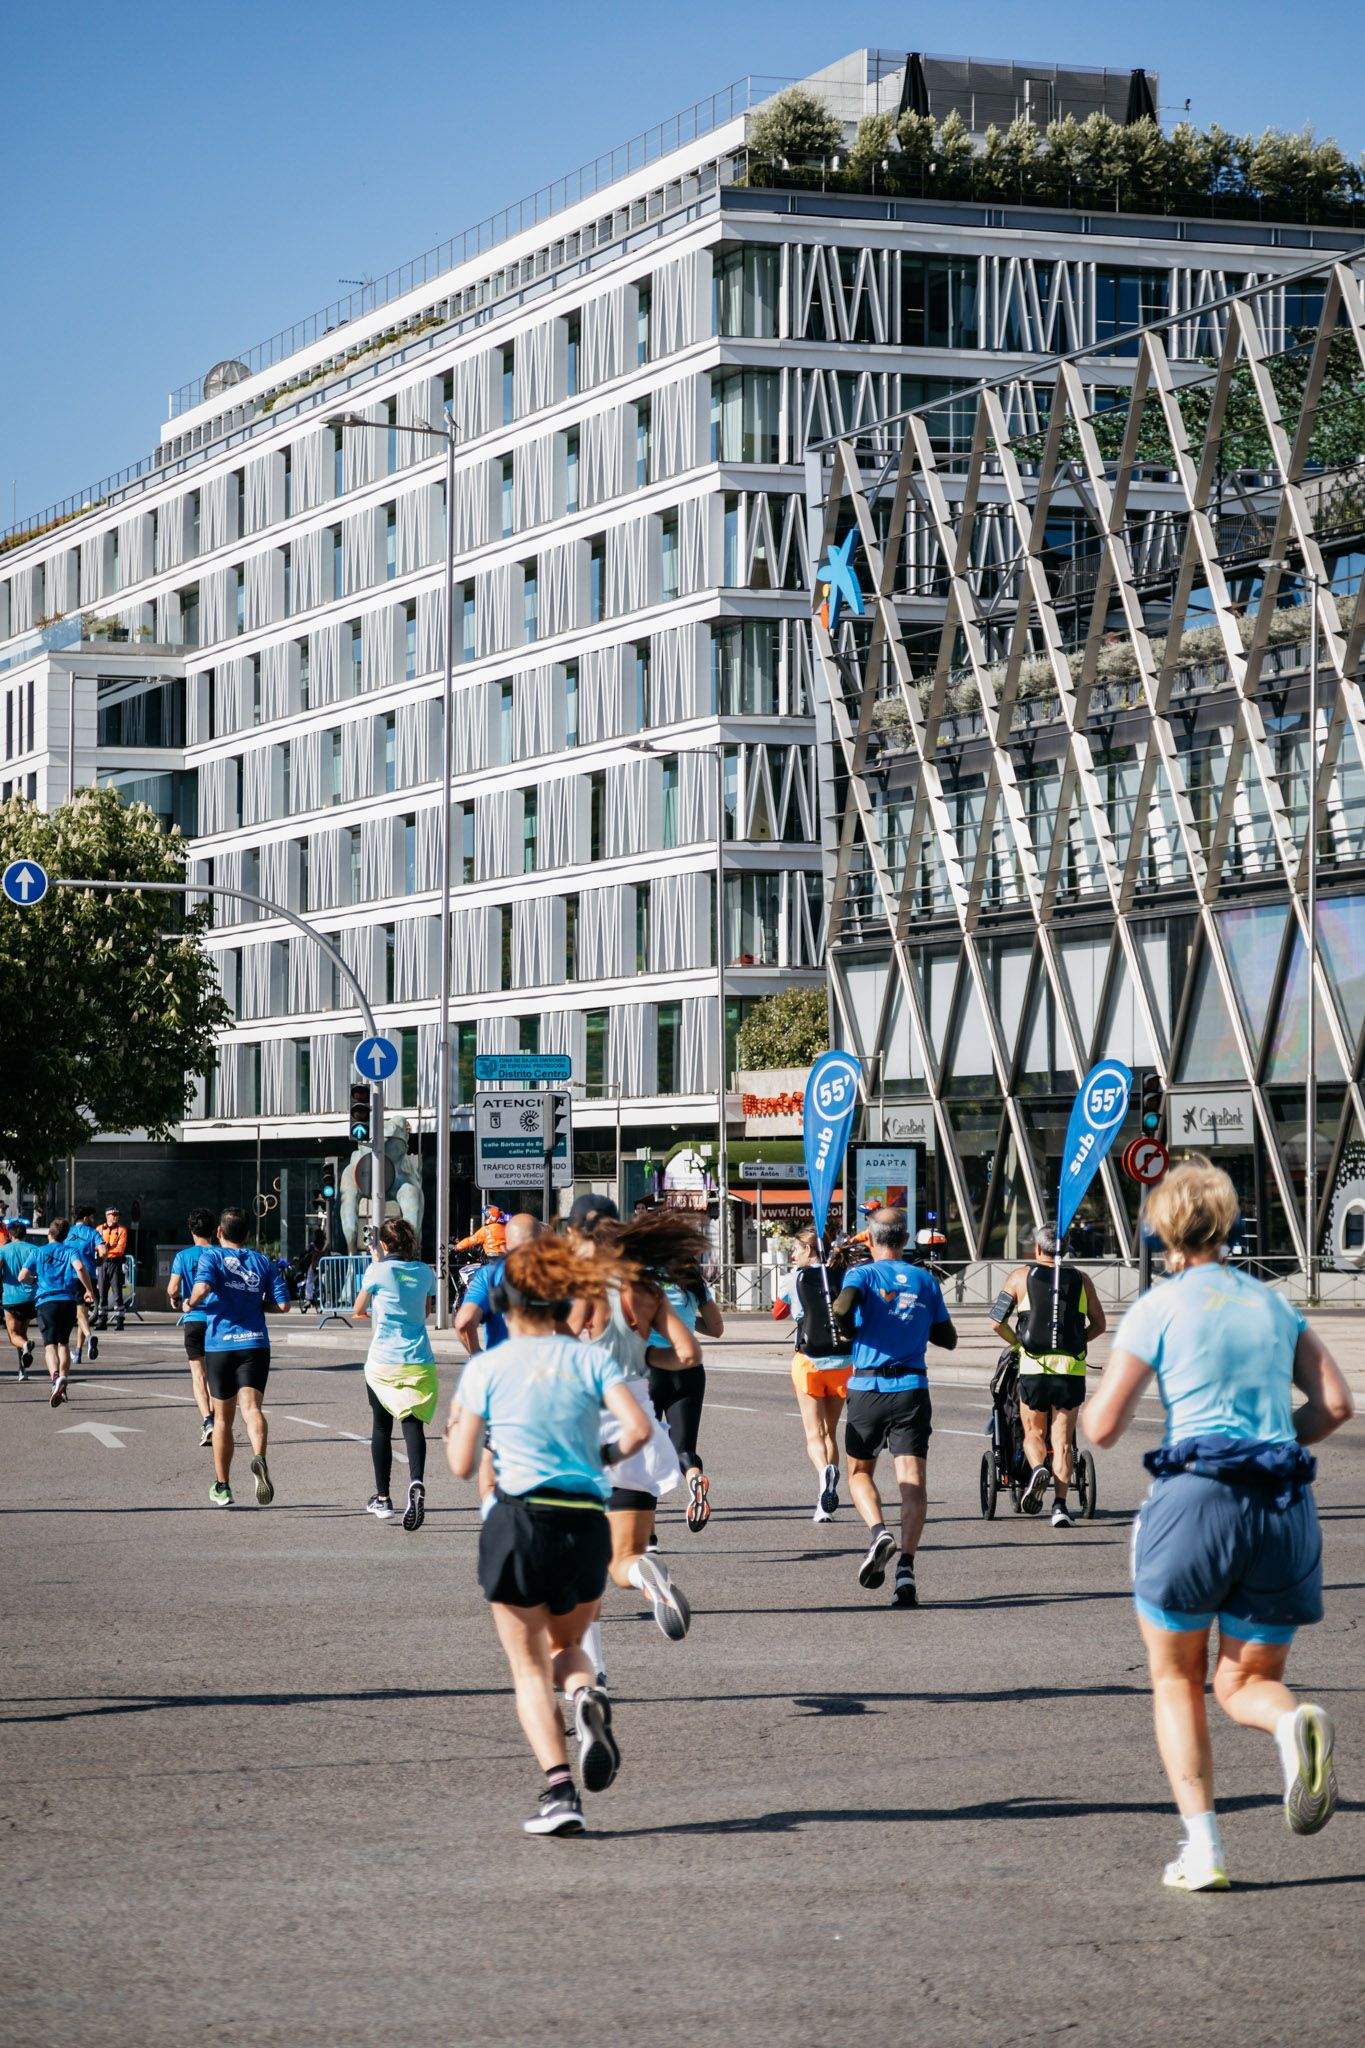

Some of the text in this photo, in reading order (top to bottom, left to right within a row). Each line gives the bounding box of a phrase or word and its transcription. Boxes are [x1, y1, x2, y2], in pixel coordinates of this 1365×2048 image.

[498, 1069, 568, 1078] Distrito Centro
[482, 1099, 565, 1108] ATENCIN
[815, 1127, 833, 1172] sub
[1069, 1133, 1095, 1176] sub
[865, 1159, 908, 1167] ADAPTA
